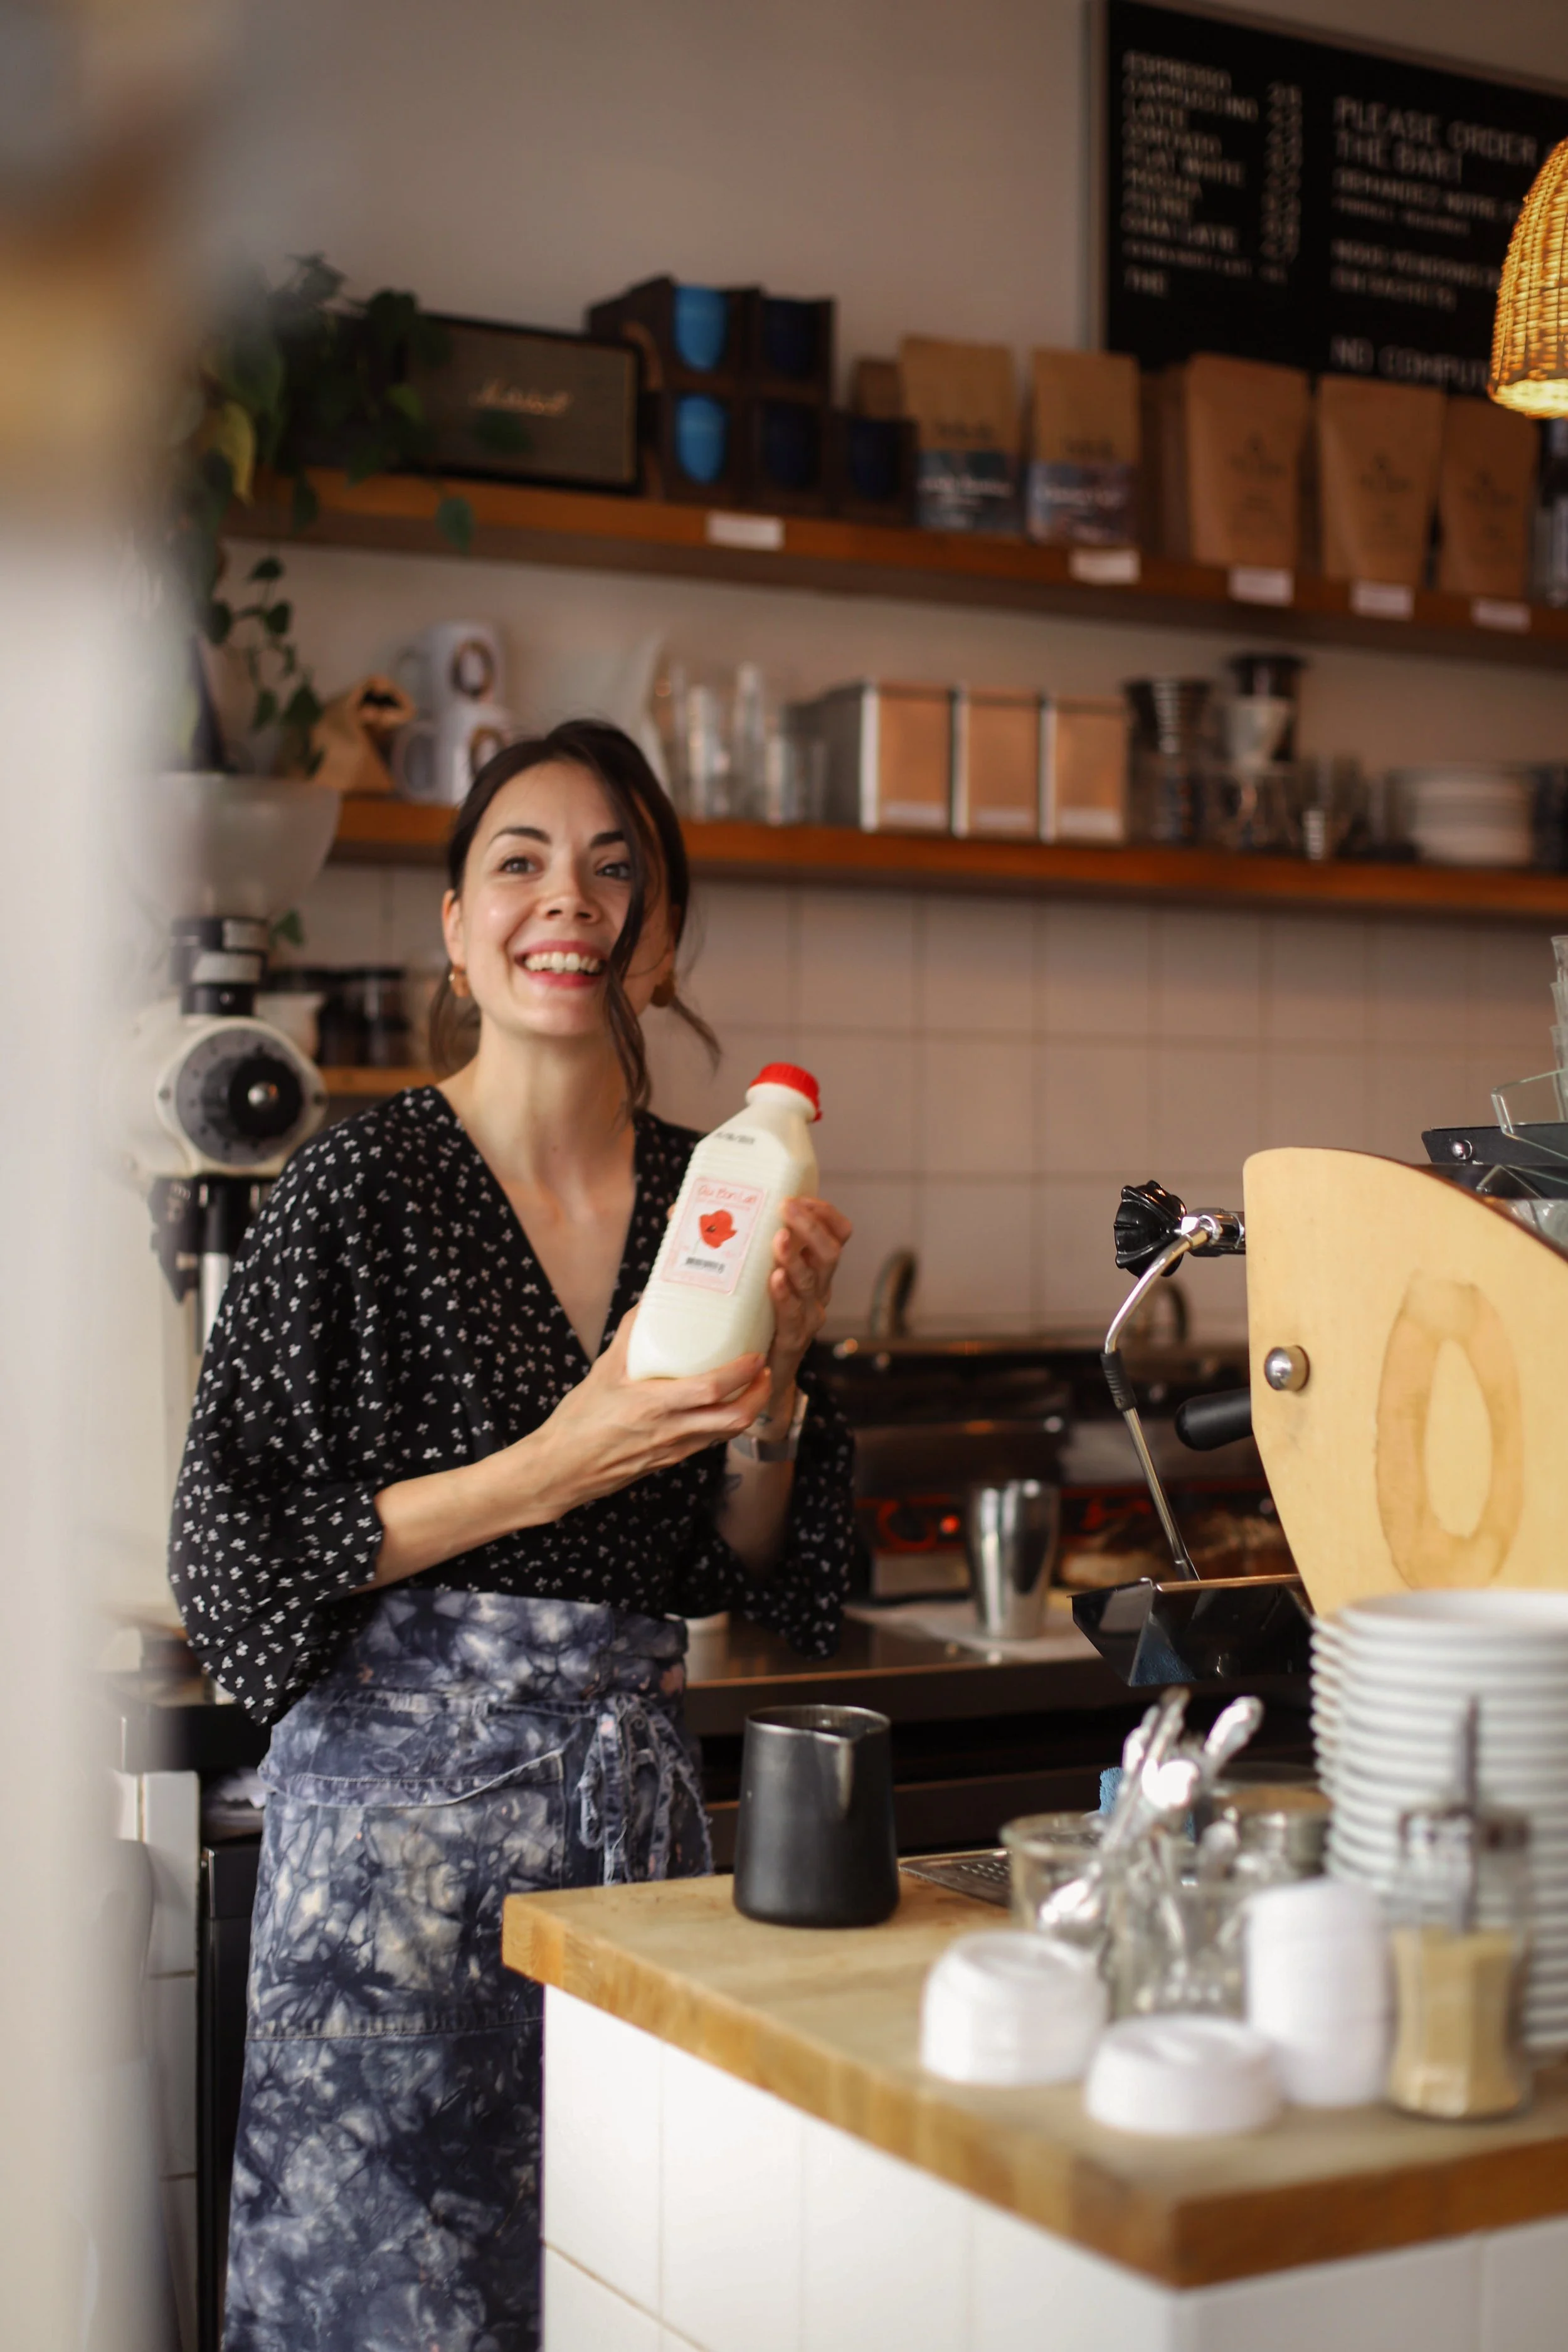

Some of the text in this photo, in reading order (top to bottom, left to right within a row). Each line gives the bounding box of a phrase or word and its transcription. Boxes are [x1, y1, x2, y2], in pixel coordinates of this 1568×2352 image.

[1335, 97, 1536, 164] PLEASE ORDER
[1337, 131, 1389, 167] THE
[1332, 336, 1488, 386] NO COMPUT
